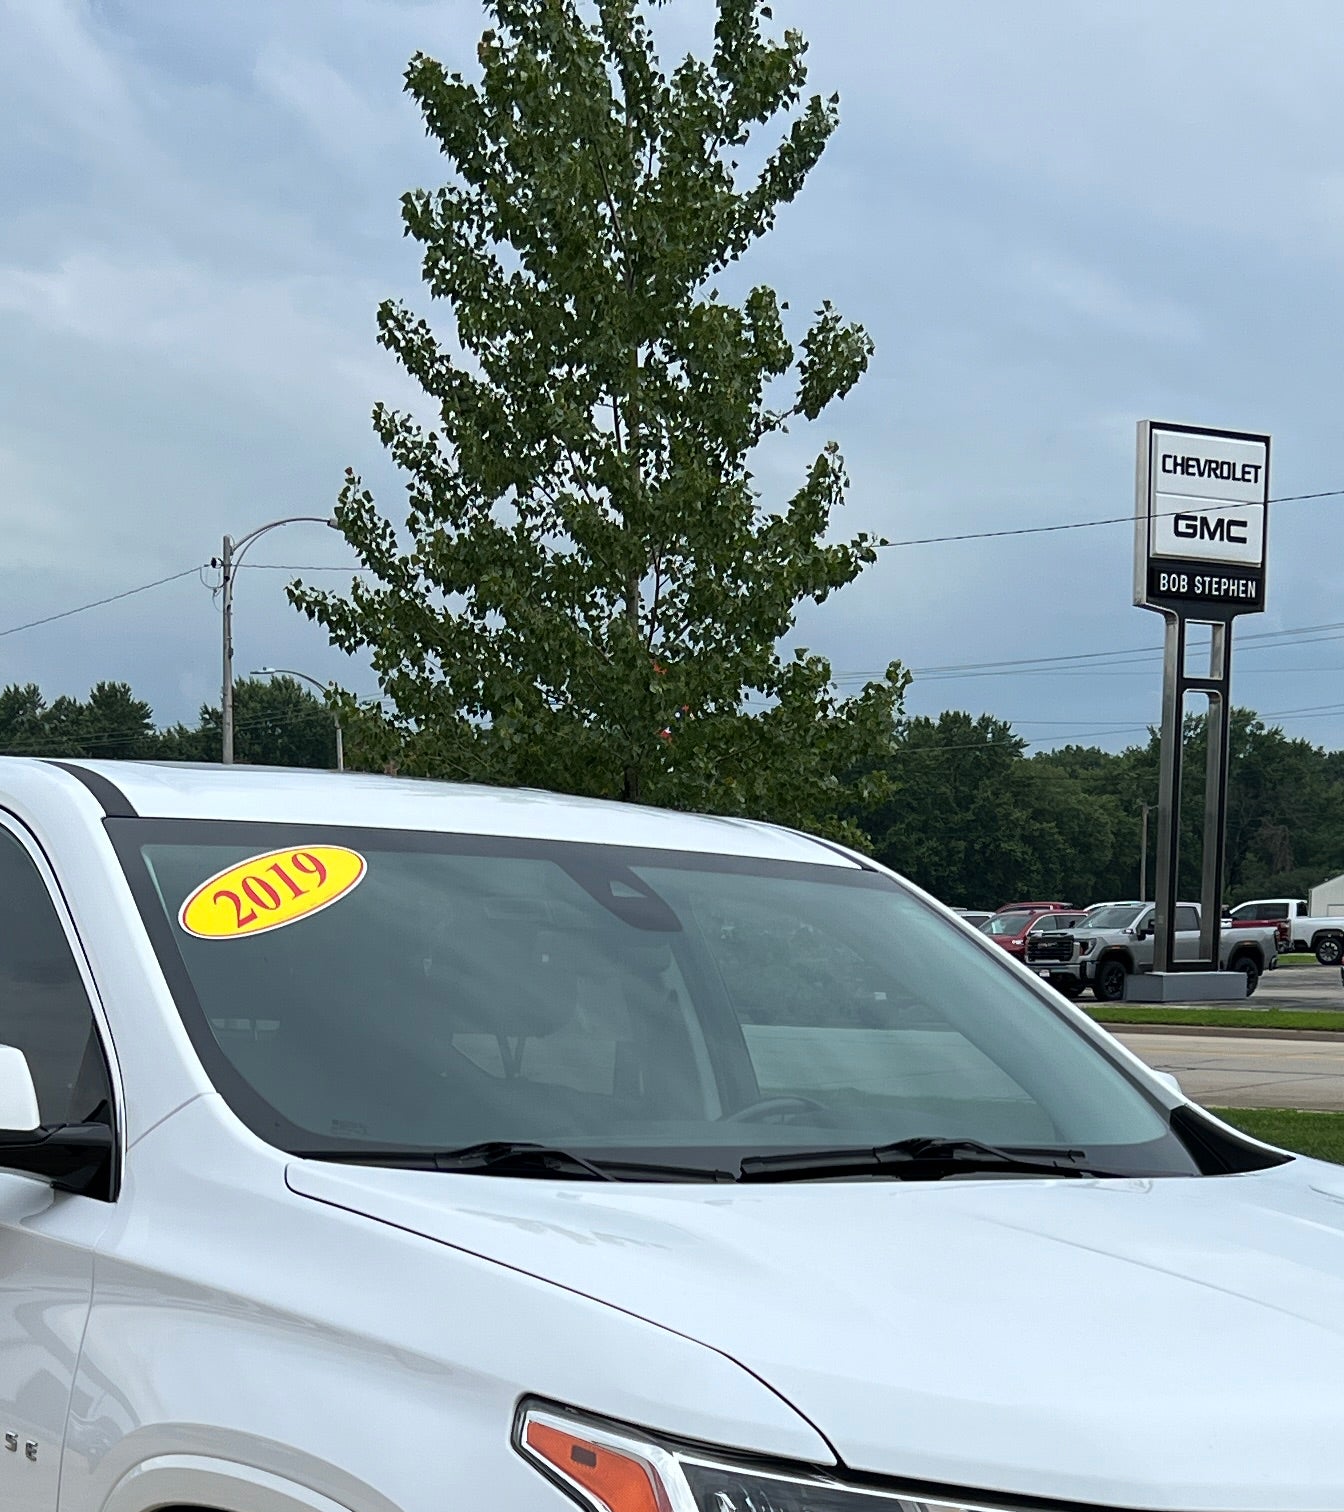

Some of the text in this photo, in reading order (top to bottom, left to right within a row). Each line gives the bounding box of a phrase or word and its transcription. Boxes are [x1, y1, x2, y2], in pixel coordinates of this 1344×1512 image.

[1162, 454, 1262, 484] CHEVROLET
[1173, 514, 1248, 544] GMC
[1159, 573, 1256, 599] BOB STEPHEN
[213, 852, 327, 928] 2019
